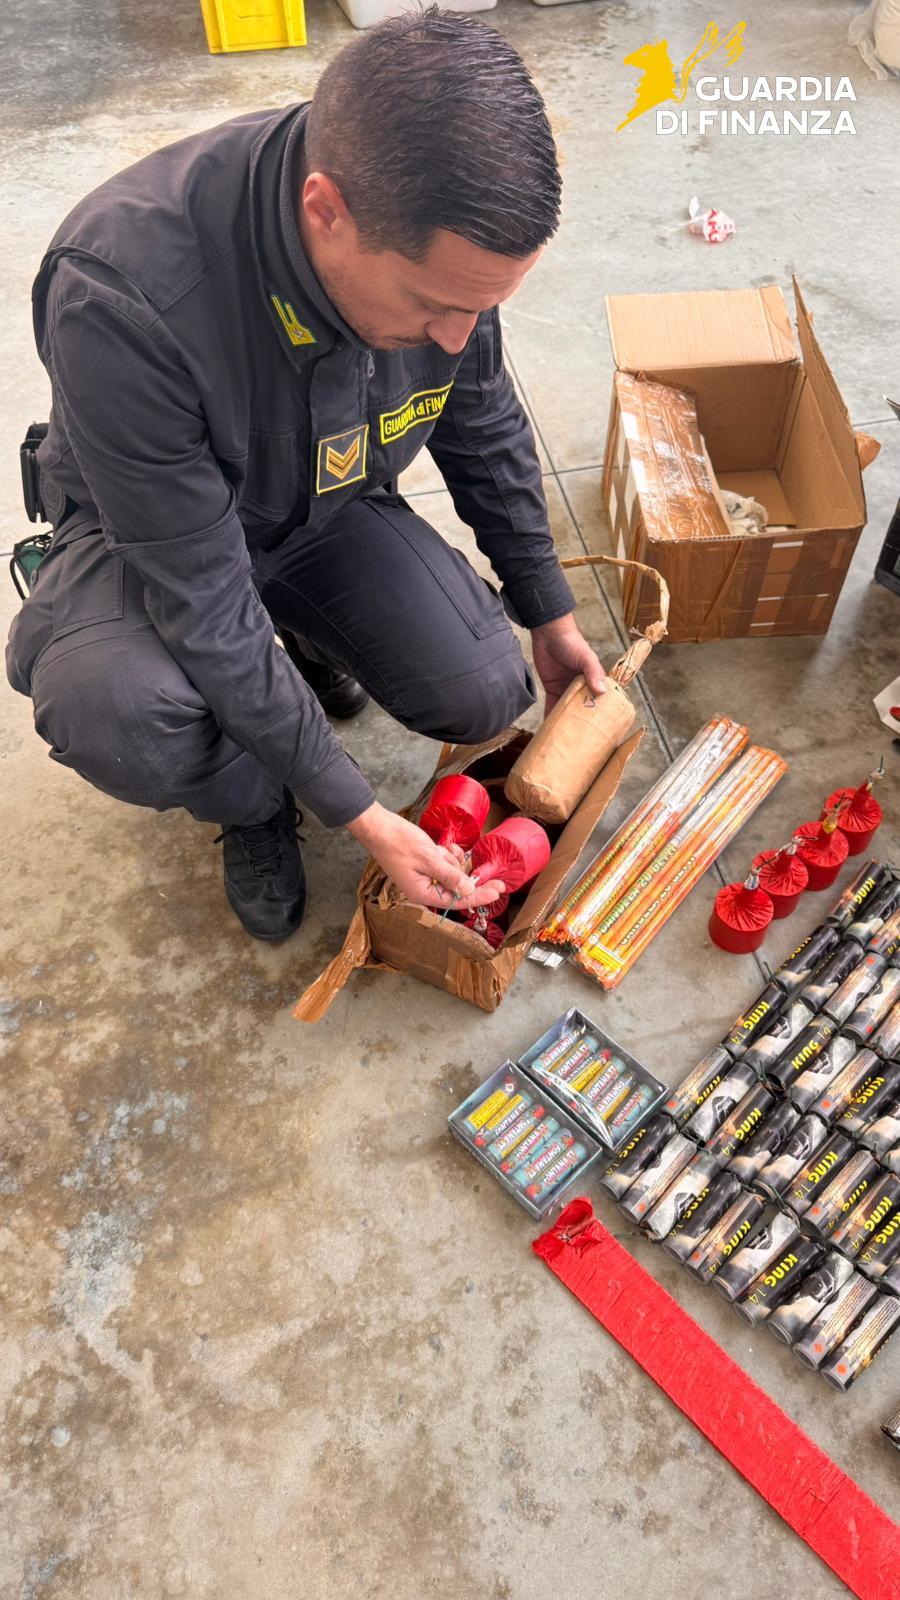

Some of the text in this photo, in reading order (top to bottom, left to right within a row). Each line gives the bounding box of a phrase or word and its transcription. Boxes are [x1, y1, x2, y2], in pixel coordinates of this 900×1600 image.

[384, 404, 416, 436] GUARDIA
[416, 399, 425, 417] di
[854, 877, 875, 904] KING
[598, 887, 639, 934] CANDELA
[730, 999, 770, 1045] KING 14
[558, 1051, 581, 1076] FONTANA
[789, 1023, 832, 1070] KING 14
[587, 1073, 611, 1099] FONTANA
[855, 1073, 885, 1107] KING
[504, 1116, 529, 1141] FONTANA
[719, 1107, 763, 1158] KING 14
[533, 1143, 560, 1170] FONTANA
[542, 1157, 568, 1183] FONTANA
[792, 1149, 839, 1201] KING 14
[720, 1219, 752, 1256] KING
[848, 1195, 893, 1250] KING 14
[707, 1257, 722, 1274] 14
[862, 1247, 878, 1263] 14
[749, 1254, 798, 1305] KING 14
